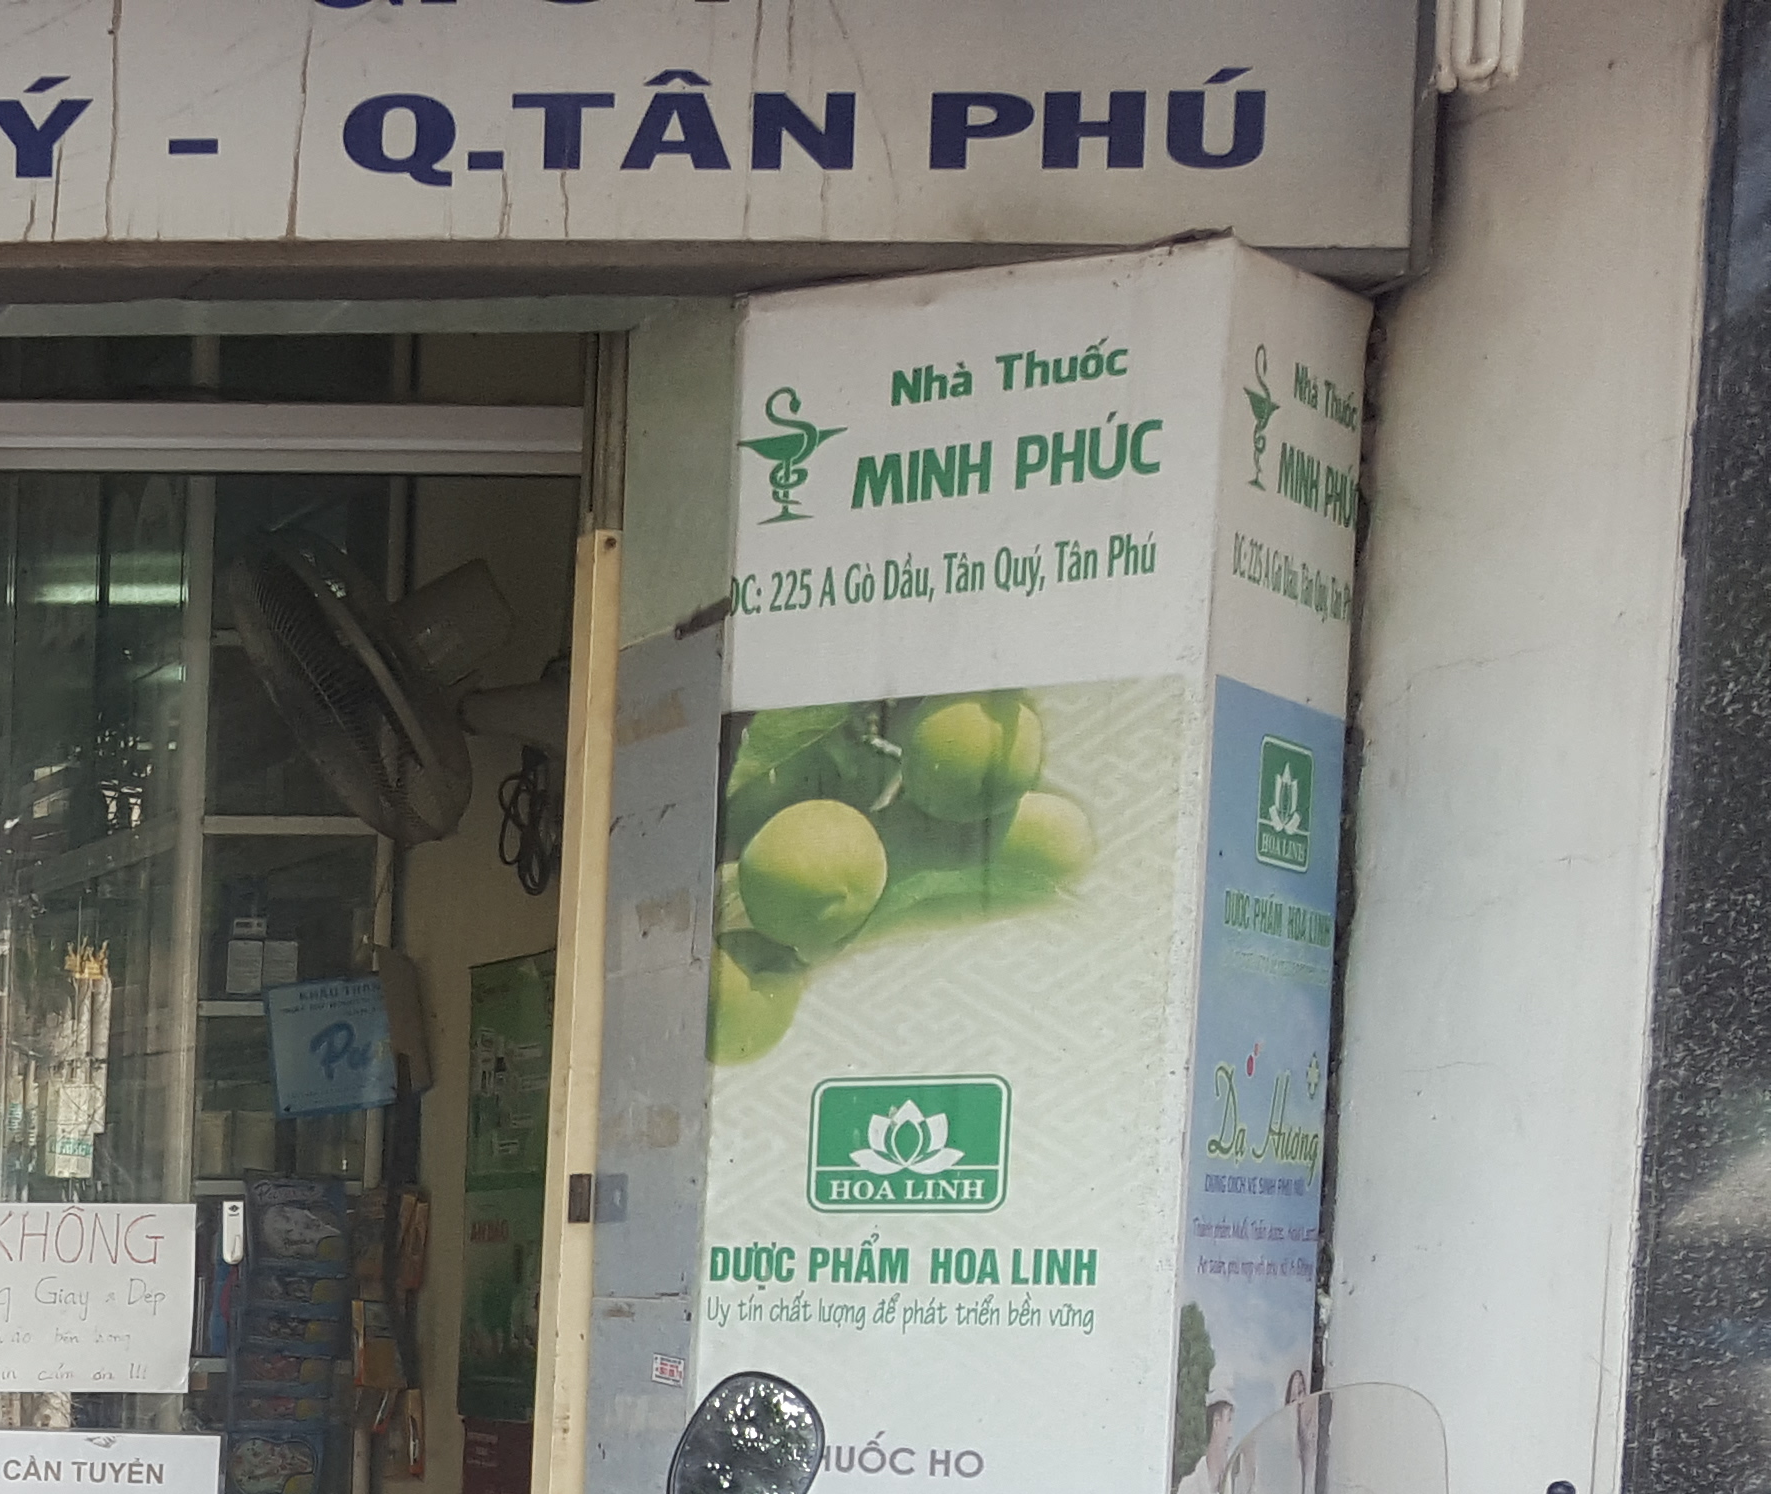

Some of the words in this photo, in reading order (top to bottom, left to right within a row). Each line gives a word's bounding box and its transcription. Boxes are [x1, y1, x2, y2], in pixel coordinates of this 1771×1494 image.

[343, 70, 863, 184] Q.TÂN
[931, 66, 1267, 173] PHÚ
[892, 361, 972, 406] Nhà
[995, 337, 1128, 391] Thuốc
[851, 441, 992, 509] MINH
[1015, 411, 1163, 490] PHÚC
[1277, 442, 1321, 513] MINH
[769, 568, 812, 613] 225
[820, 566, 836, 609] A
[845, 562, 875, 605] Gò
[884, 552, 935, 603] Dầu,
[943, 545, 985, 595] Tân
[994, 544, 1046, 597] Quý,
[1054, 536, 1098, 584] Tân
[1108, 529, 1157, 578] Phú
[830, 1180, 895, 1200] HOA
[903, 1179, 985, 1200] LINH
[808, 1232, 909, 1284] PHẨM
[929, 1247, 1000, 1285] HOA
[1011, 1247, 1098, 1286] LINH
[706, 1297, 730, 1327] Uy
[738, 1296, 763, 1322] tín
[769, 1291, 813, 1323] chất
[818, 1297, 866, 1330] lượng
[873, 1293, 900, 1323] để
[902, 1297, 947, 1334] phát
[955, 1294, 1000, 1326] triển
[1007, 1292, 1041, 1327] bền
[1049, 1302, 1095, 1335] vững
[3, 1455, 62, 1482] CẦN
[71, 1457, 164, 1484] TUYỂN
[929, 1450, 984, 1478] HO
